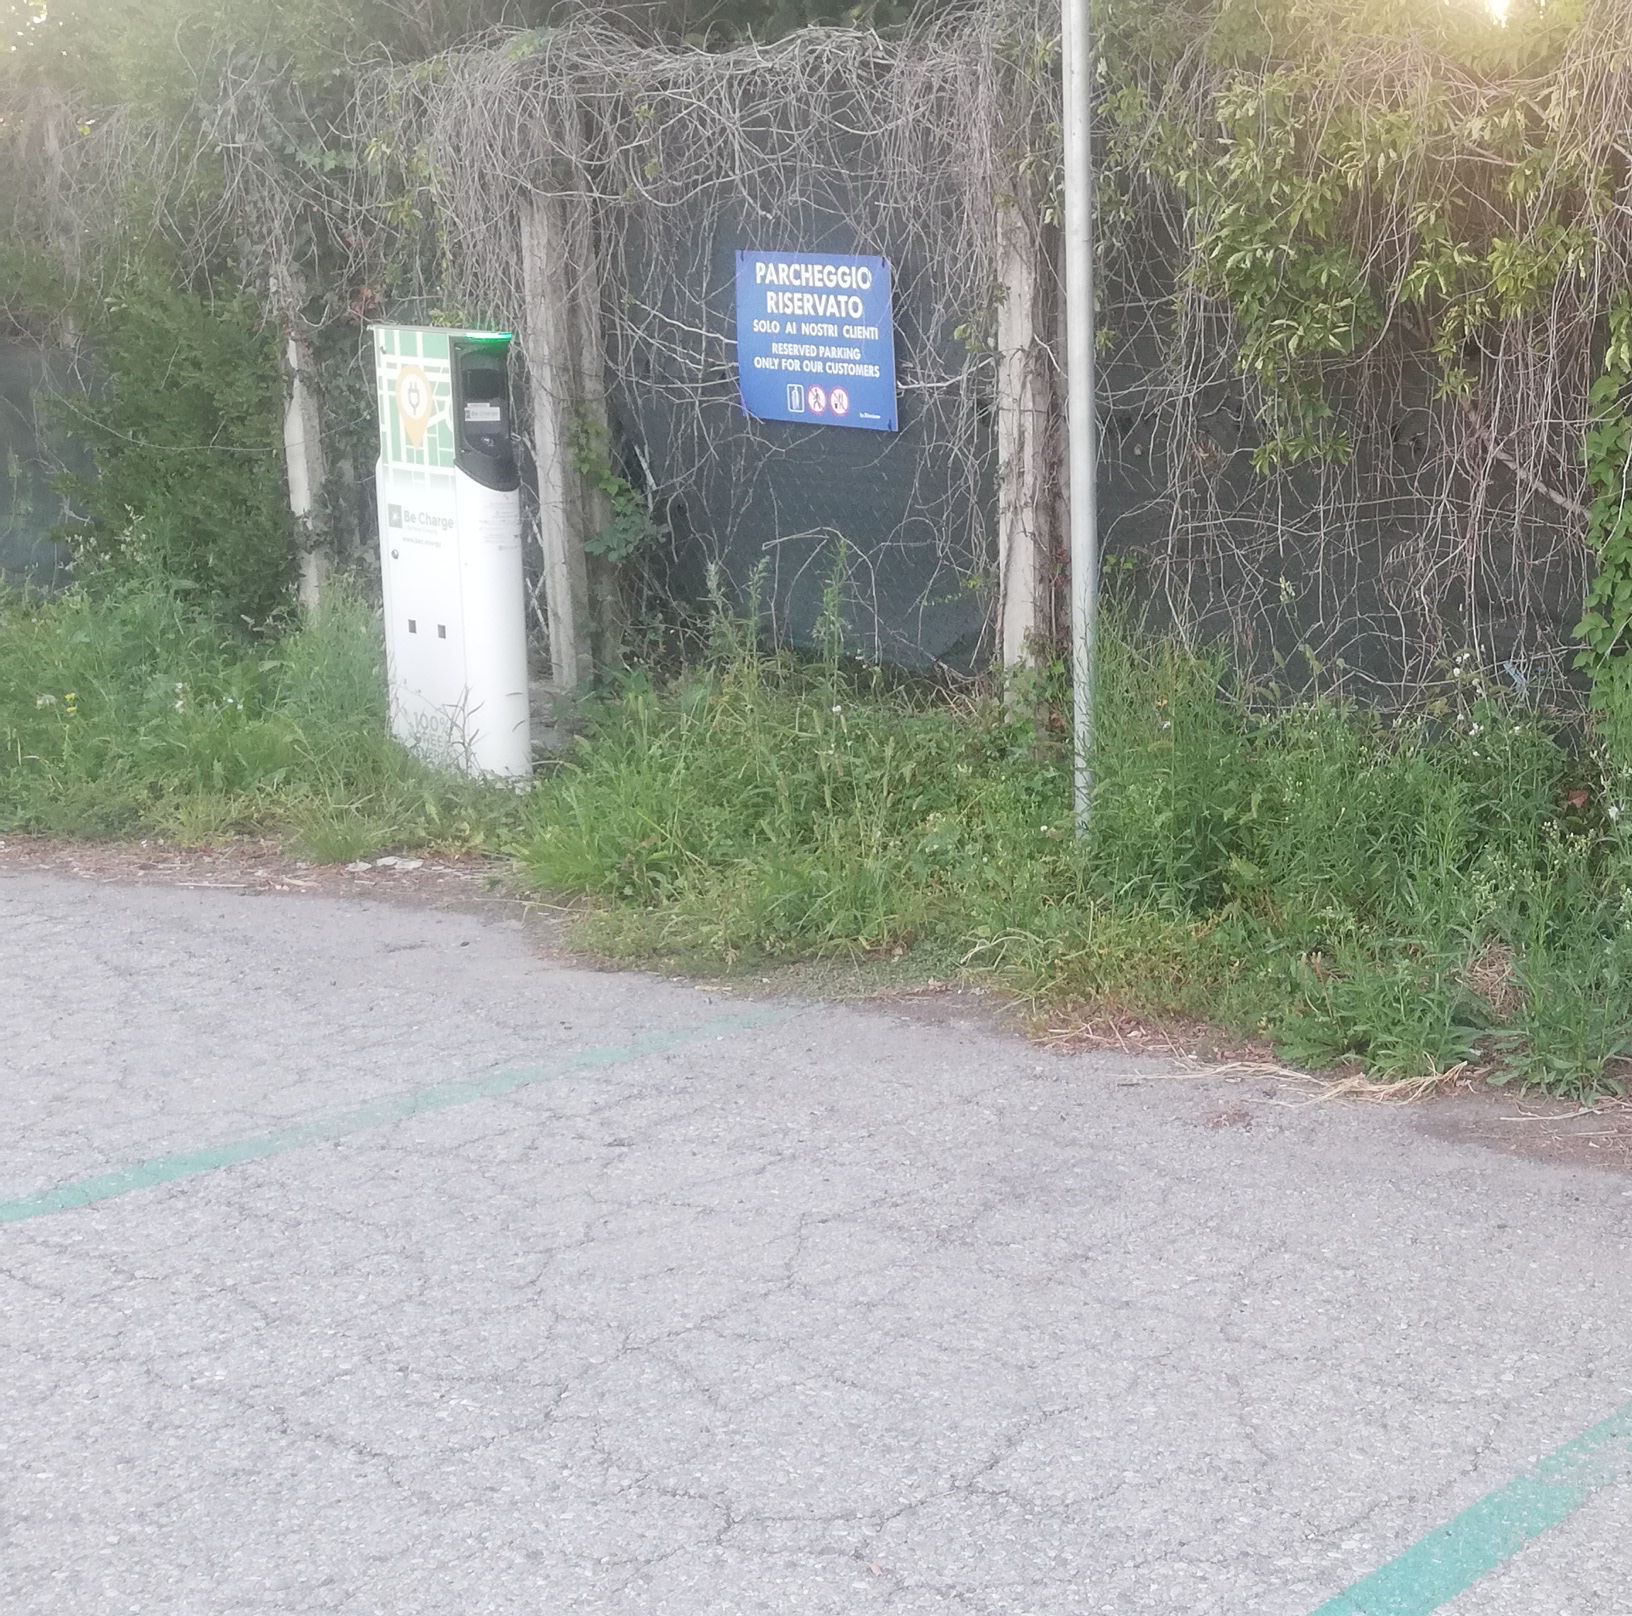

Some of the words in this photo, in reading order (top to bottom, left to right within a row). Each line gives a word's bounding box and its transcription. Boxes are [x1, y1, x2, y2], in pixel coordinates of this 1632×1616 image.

[755, 261, 873, 290] PARCHEGGIO
[766, 291, 864, 319] RISERVATO
[753, 319, 780, 334] SOLO
[785, 322, 797, 335] AI
[801, 322, 838, 337] NOSTRI
[842, 325, 879, 340] CLIENTI
[771, 342, 817, 357] RESERVED
[819, 345, 862, 360] PARKING
[753, 356, 780, 370] ONLY
[781, 359, 801, 372] FOR
[802, 361, 824, 374] OUR
[825, 362, 880, 378] CUSTOMERS
[403, 510, 417, 523] Be
[418, 512, 455, 531] Charge
